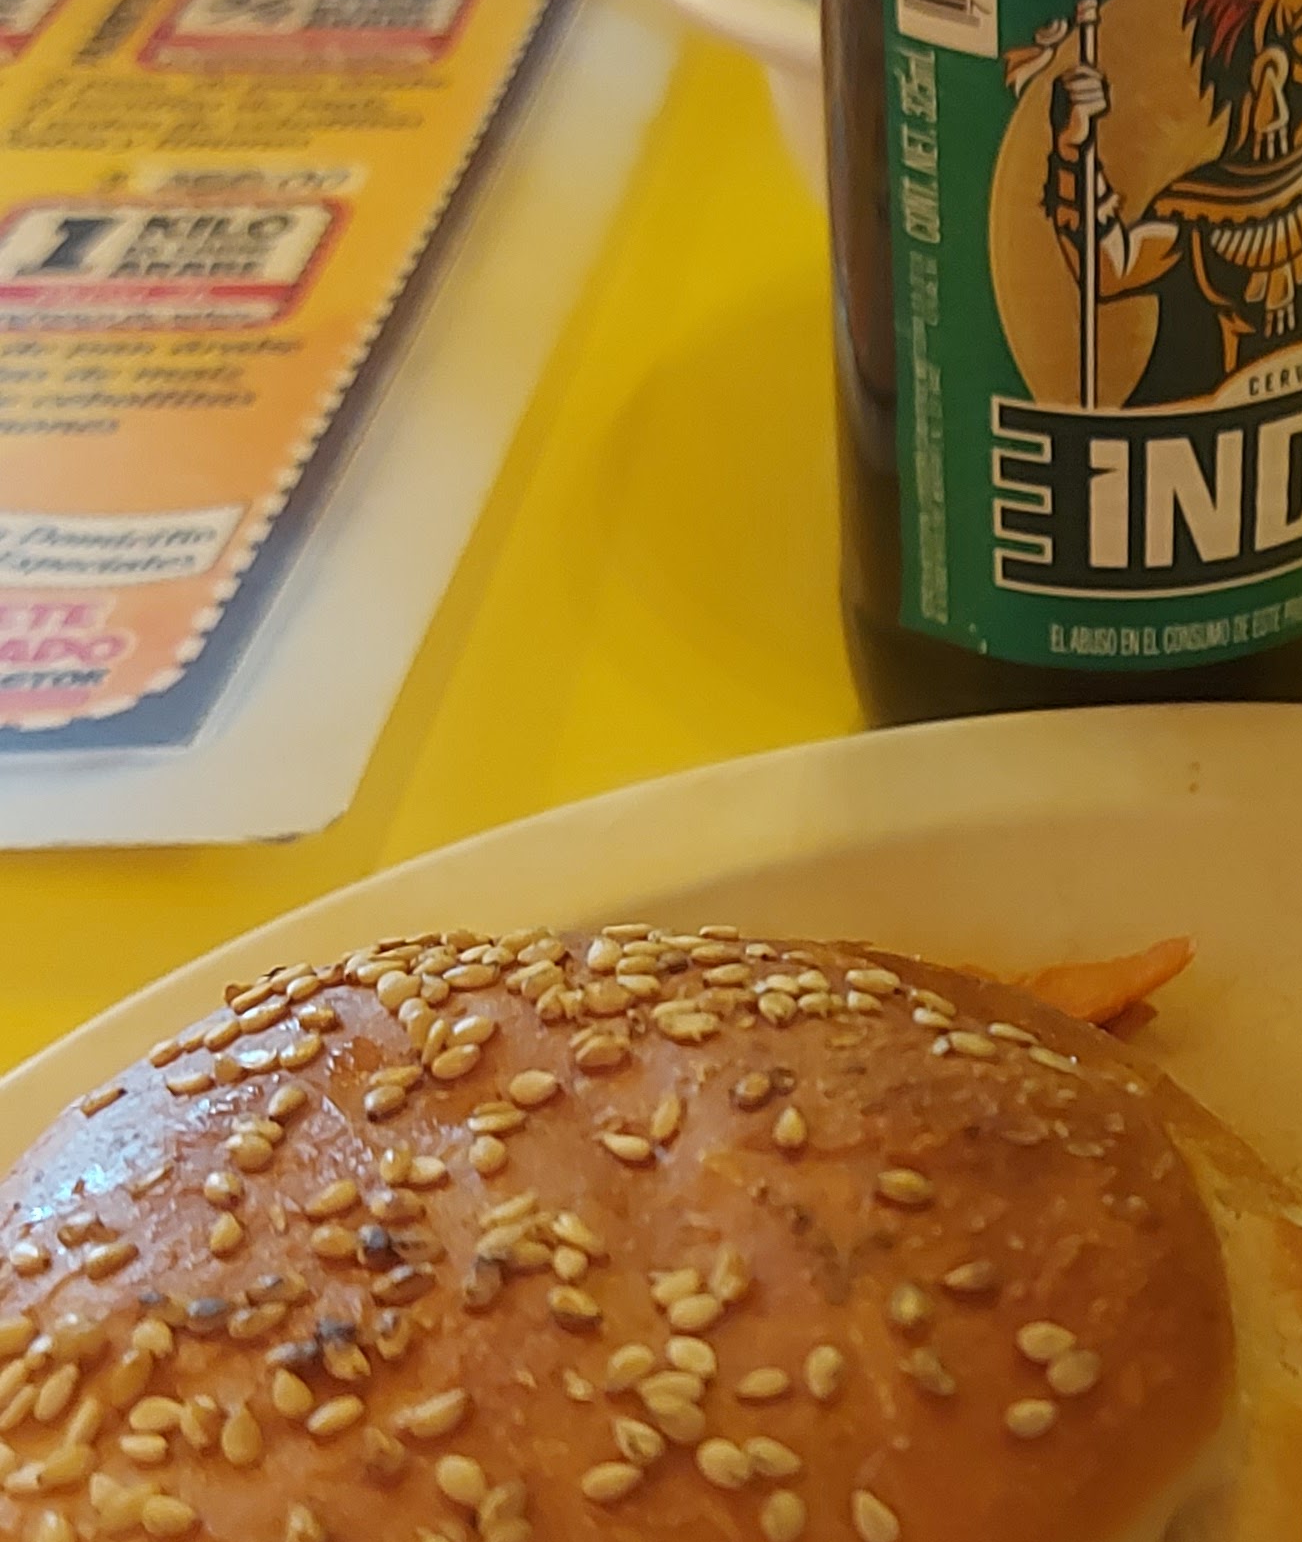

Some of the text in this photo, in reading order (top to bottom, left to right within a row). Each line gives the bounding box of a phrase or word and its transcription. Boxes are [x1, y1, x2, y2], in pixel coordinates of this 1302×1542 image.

[138, 216, 291, 241] KILO
[1051, 623, 1065, 653] EL
[1070, 624, 1117, 655] ABUSO
[1121, 625, 1140, 656] EN
[1143, 626, 1160, 655] EL
[1163, 618, 1231, 655] CONSUMO
